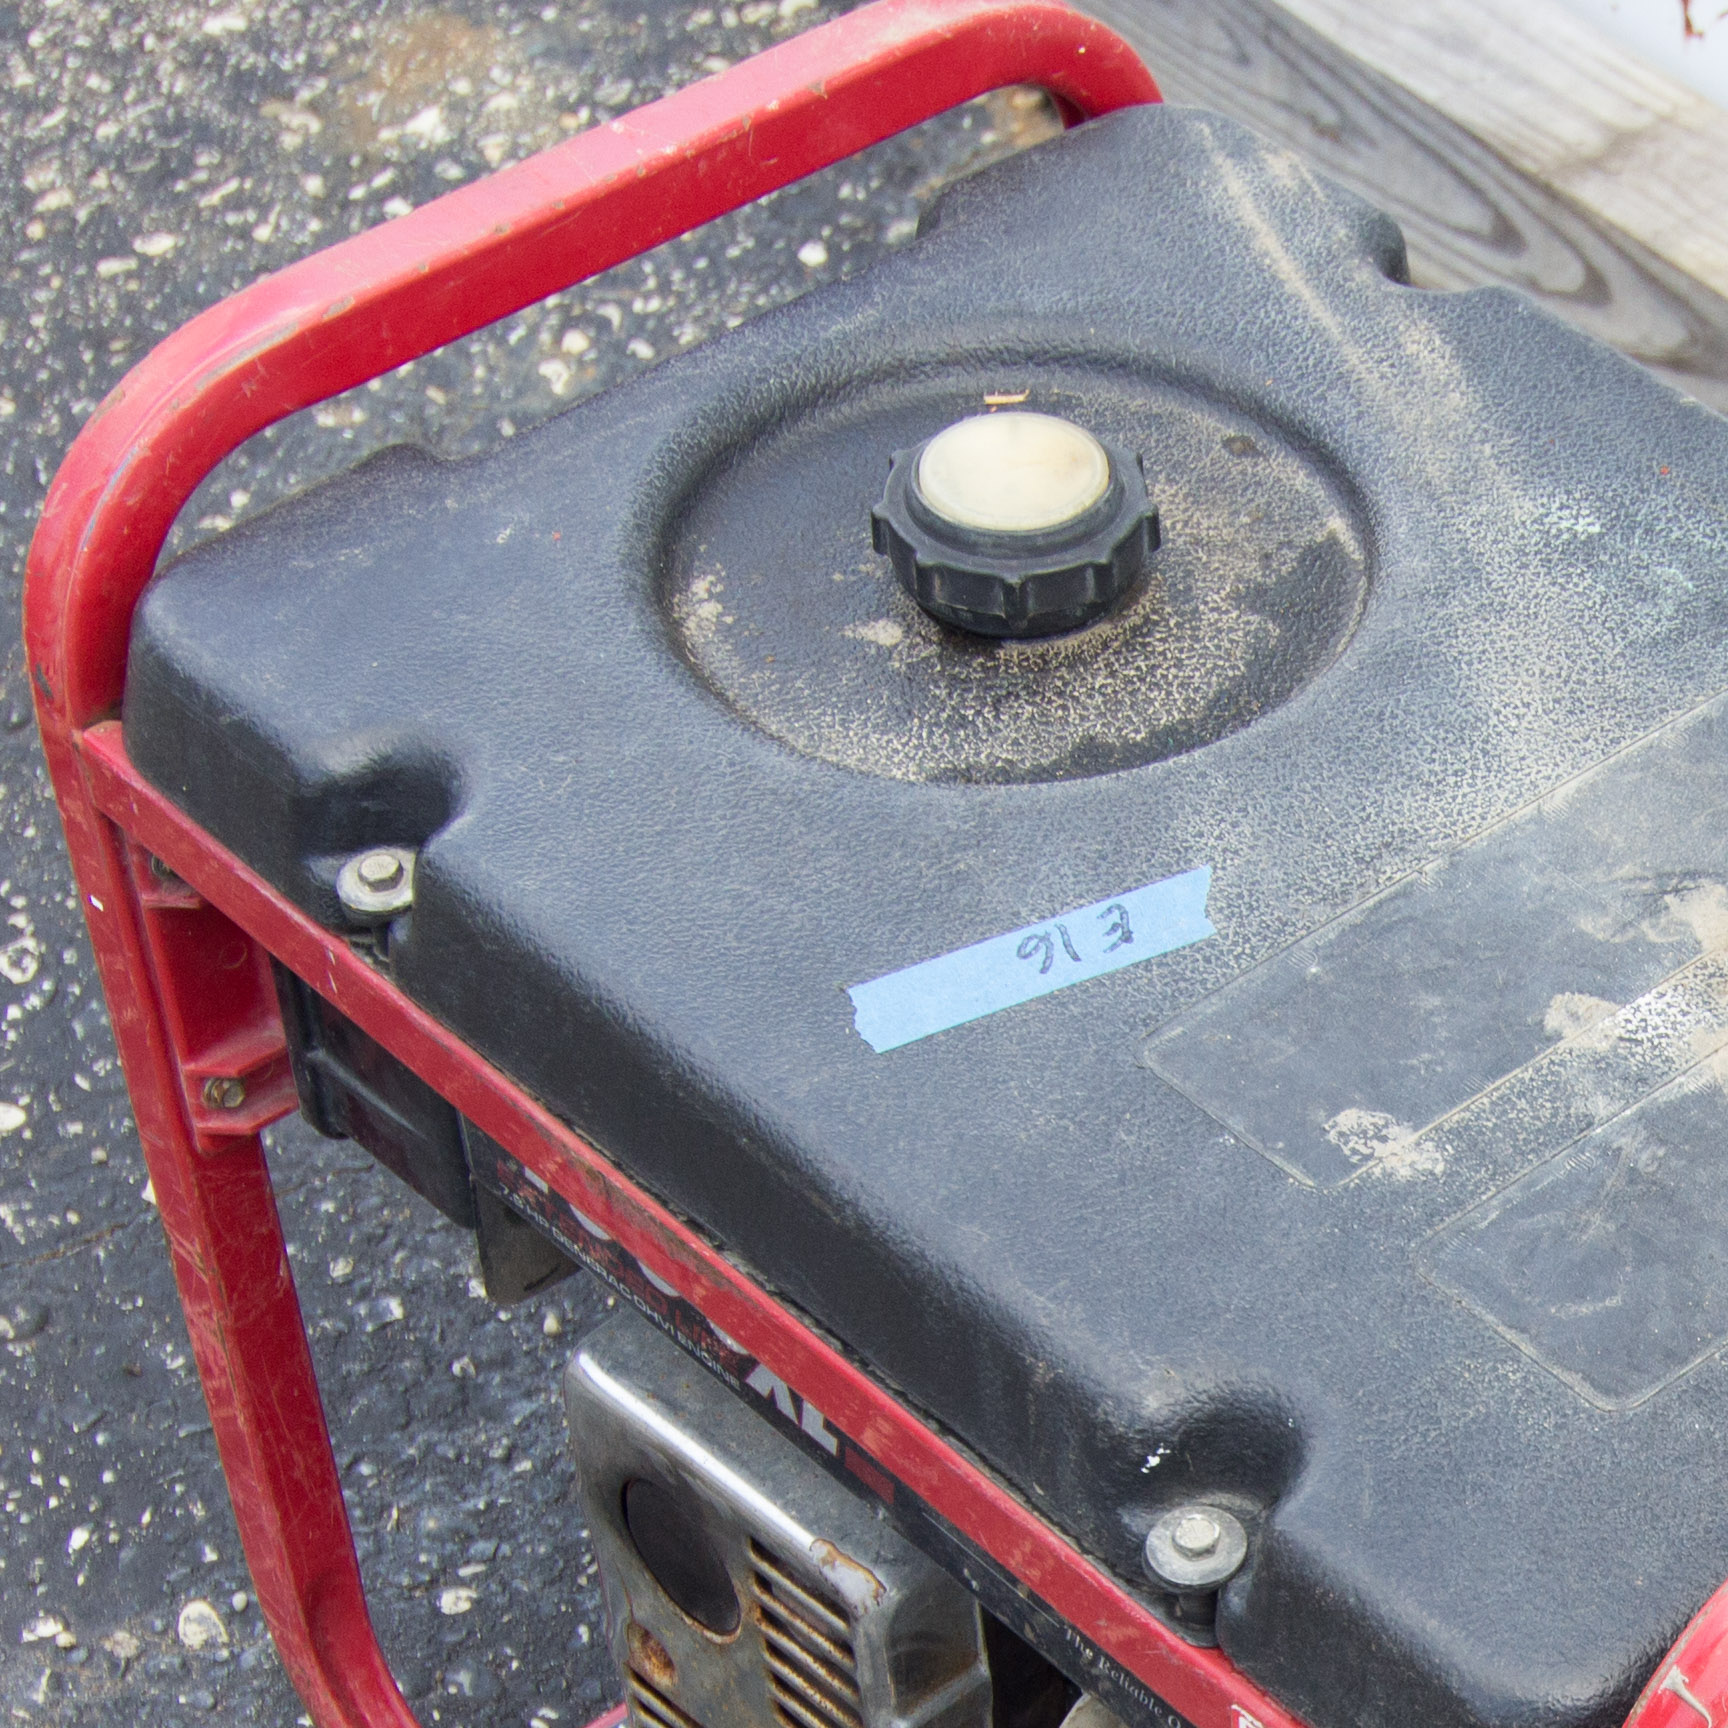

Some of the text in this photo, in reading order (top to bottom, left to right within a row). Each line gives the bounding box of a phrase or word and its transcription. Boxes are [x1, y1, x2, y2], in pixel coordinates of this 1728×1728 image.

[551, 1226, 632, 1300] GENERAC
[677, 1332, 741, 1391] ENGINE
[1063, 1623, 1095, 1660] The
[1098, 1655, 1164, 1719] Reliable
